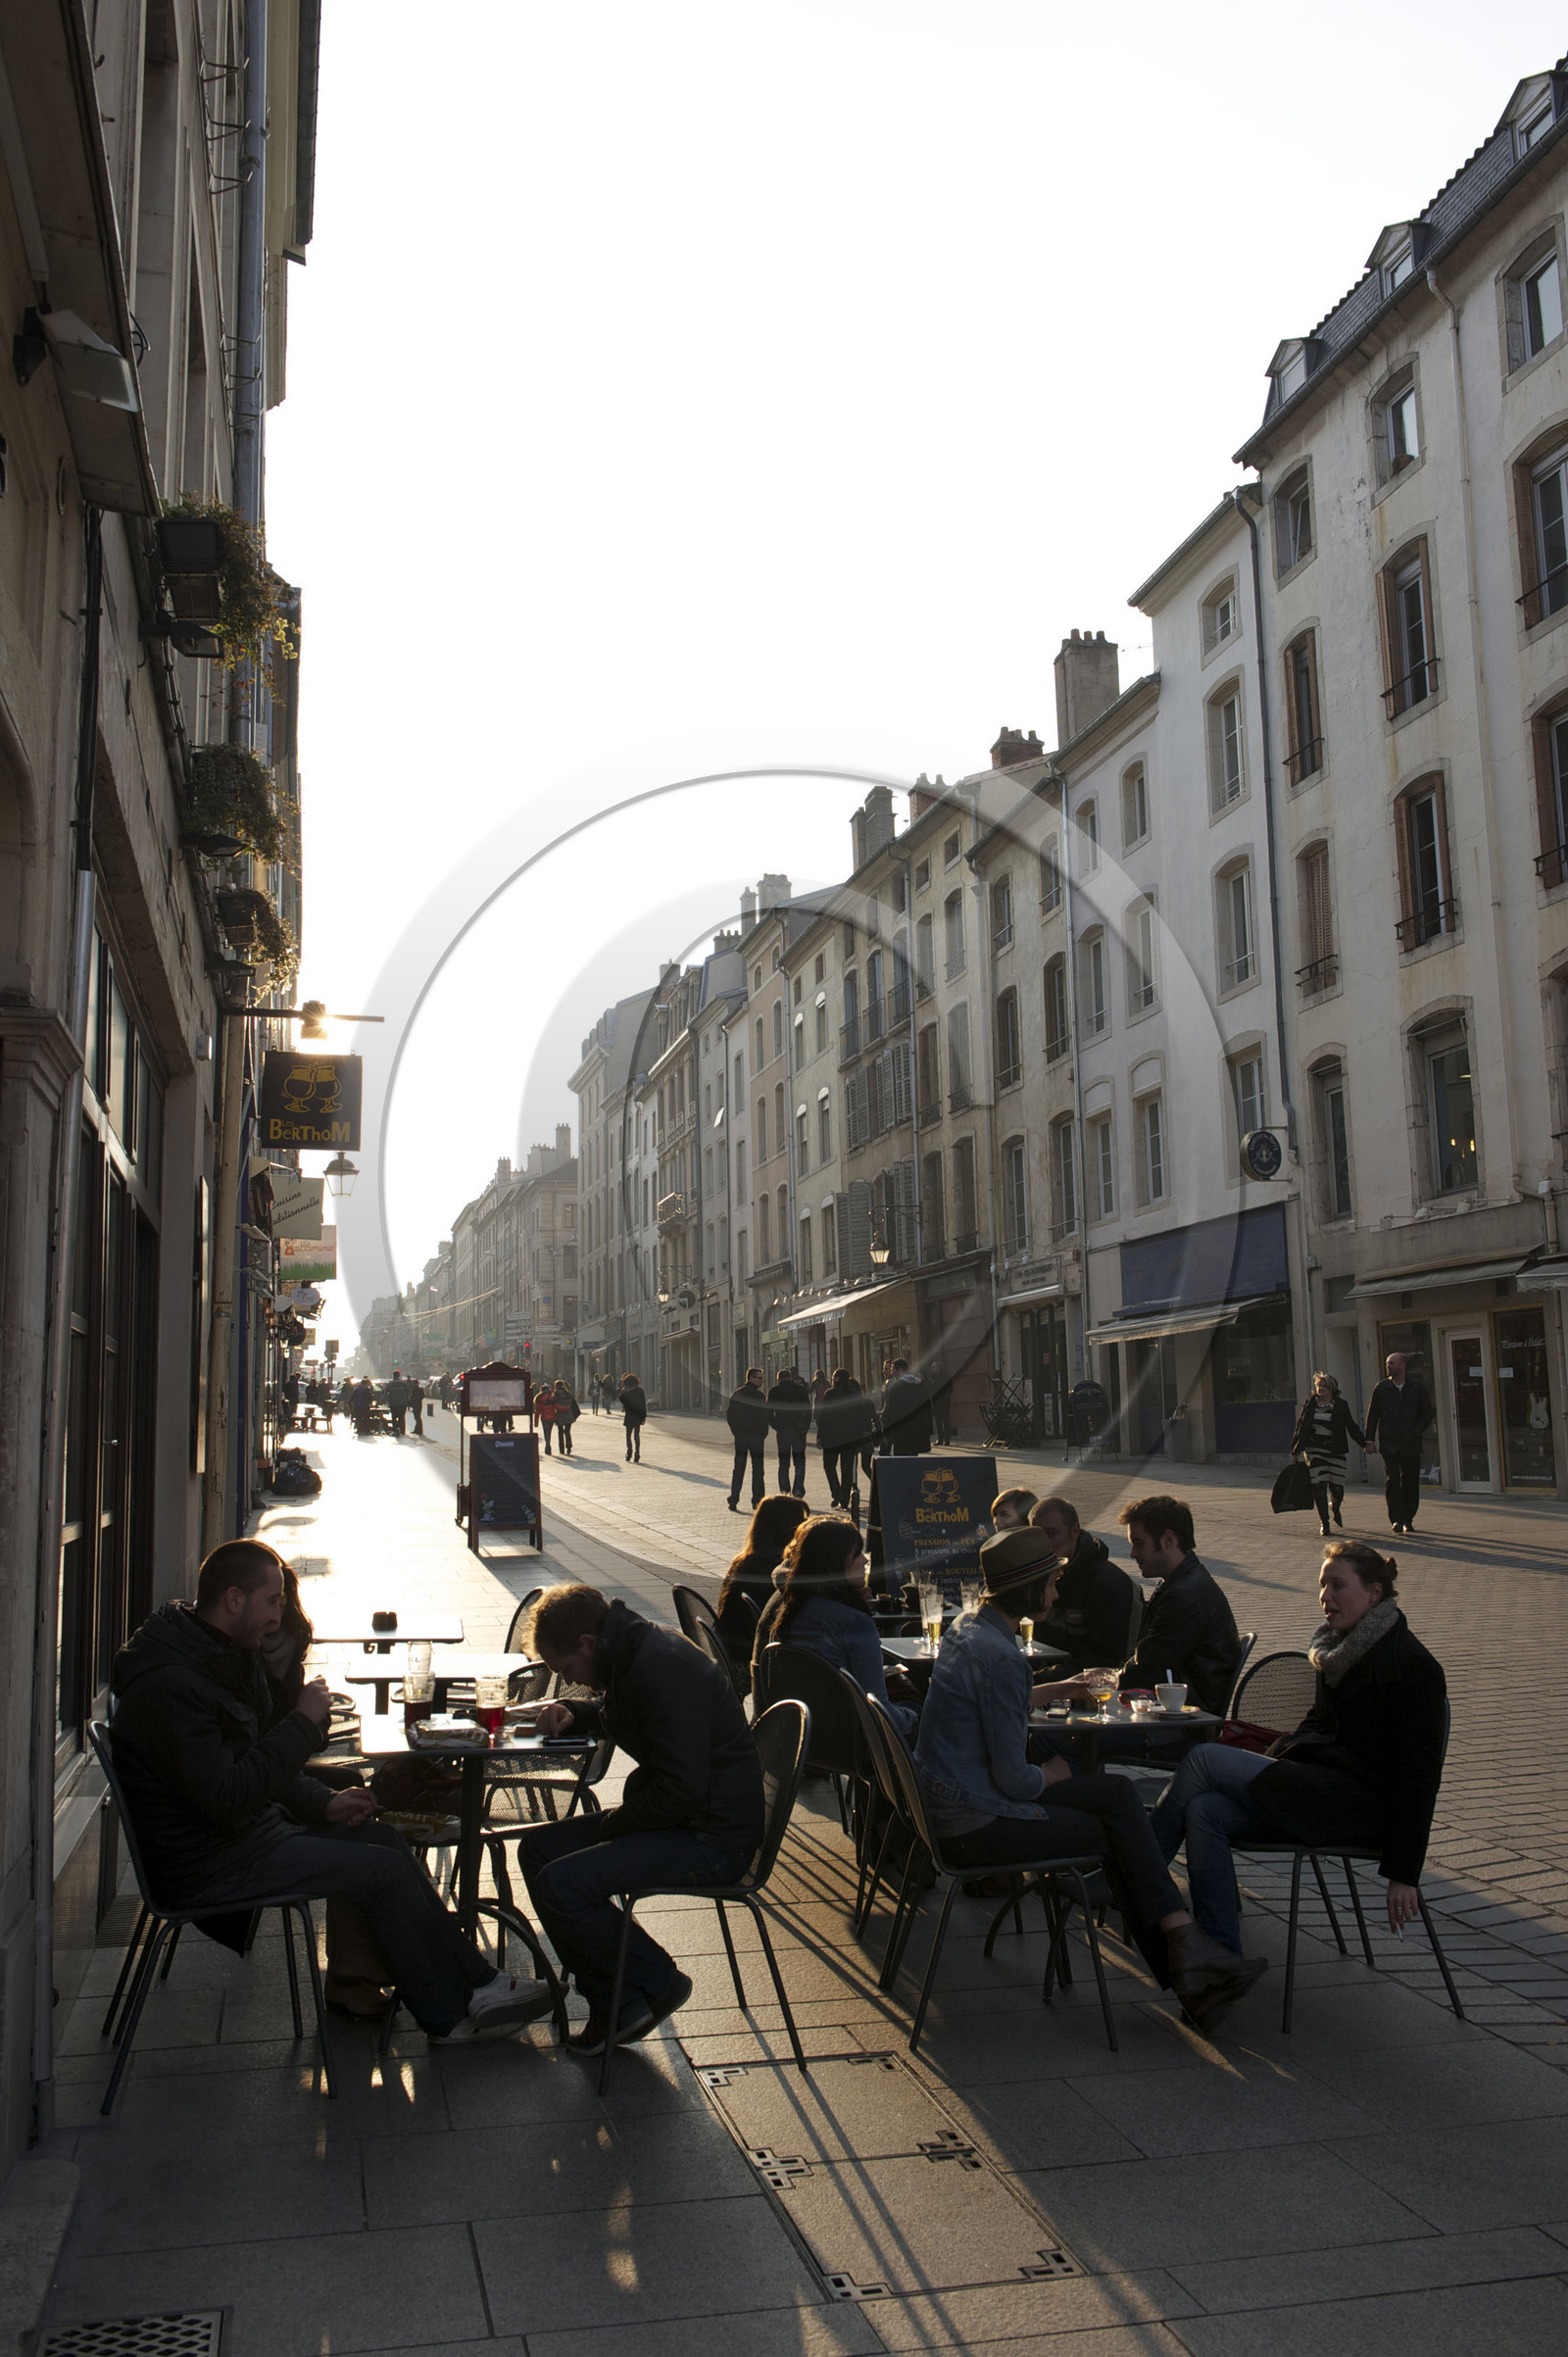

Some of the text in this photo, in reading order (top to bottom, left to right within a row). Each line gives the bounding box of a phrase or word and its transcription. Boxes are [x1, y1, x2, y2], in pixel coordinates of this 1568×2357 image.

[270, 1191, 303, 1210] Cuisine
[271, 1196, 320, 1226] aditionnelle
[920, 1547, 951, 1556] pressions
